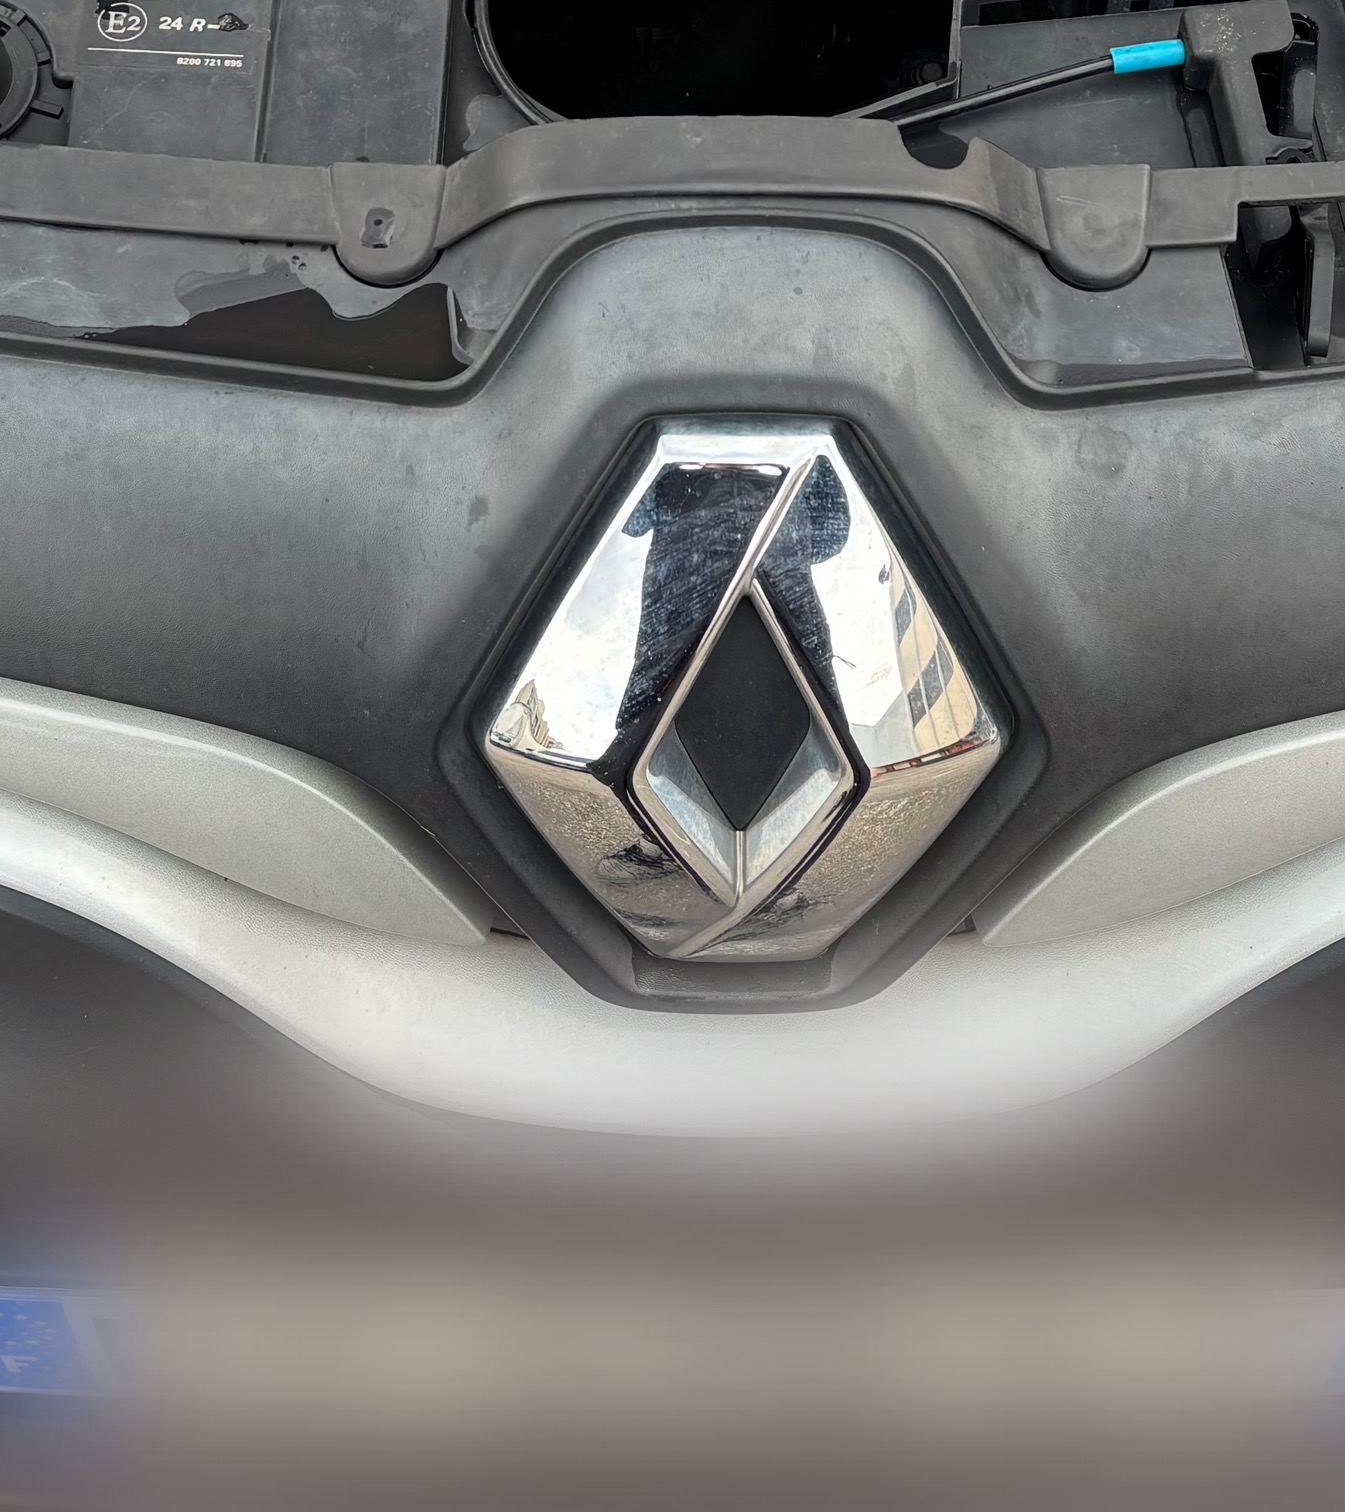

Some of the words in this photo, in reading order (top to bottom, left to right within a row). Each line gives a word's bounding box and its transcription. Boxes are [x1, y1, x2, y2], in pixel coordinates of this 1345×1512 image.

[105, 11, 142, 34] E2
[158, 17, 184, 30] 24
[176, 57, 202, 66] 8200
[204, 58, 221, 67] 721
[0, 1354, 38, 1373] F
